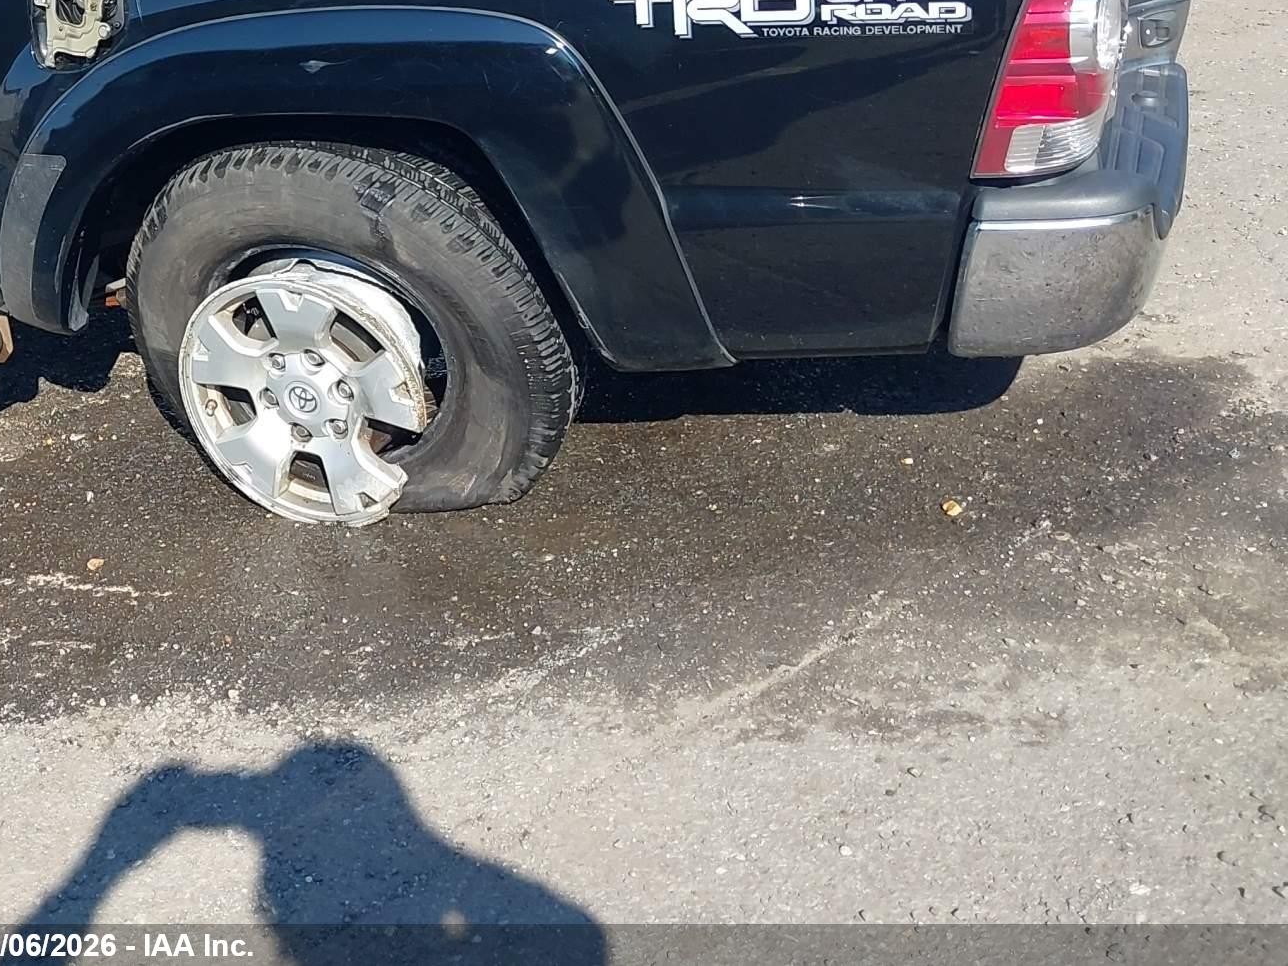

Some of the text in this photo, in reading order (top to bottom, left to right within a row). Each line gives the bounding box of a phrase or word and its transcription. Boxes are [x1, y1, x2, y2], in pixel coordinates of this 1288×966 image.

[820, 1, 972, 23] ROAD
[761, 24, 963, 37] TOYOTA RACING DEVELOPMENT
